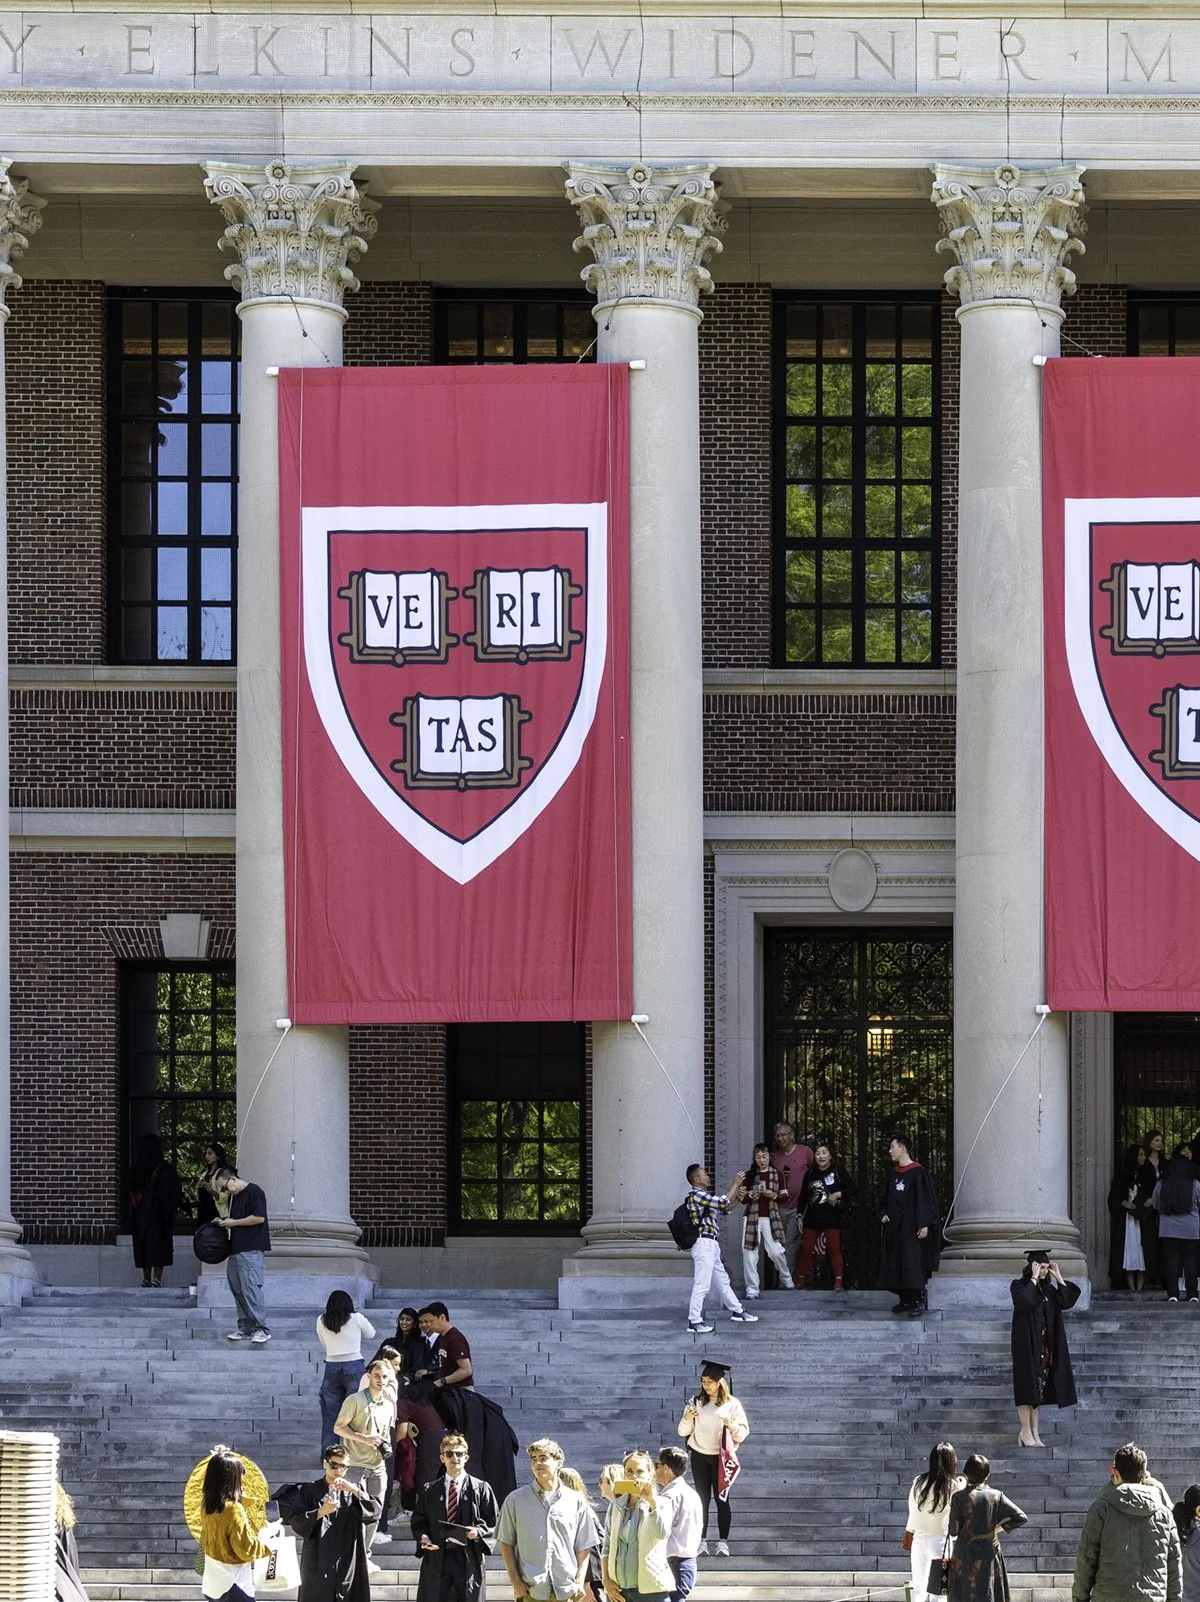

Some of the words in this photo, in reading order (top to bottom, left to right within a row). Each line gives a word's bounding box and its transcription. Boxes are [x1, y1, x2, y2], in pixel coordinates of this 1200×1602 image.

[123, 25, 478, 79] ELKINS
[559, 28, 1041, 82] WIDENER
[368, 595, 423, 629] VE
[496, 592, 541, 628] RI
[1129, 586, 1184, 620] VE
[428, 717, 497, 752] TAS
